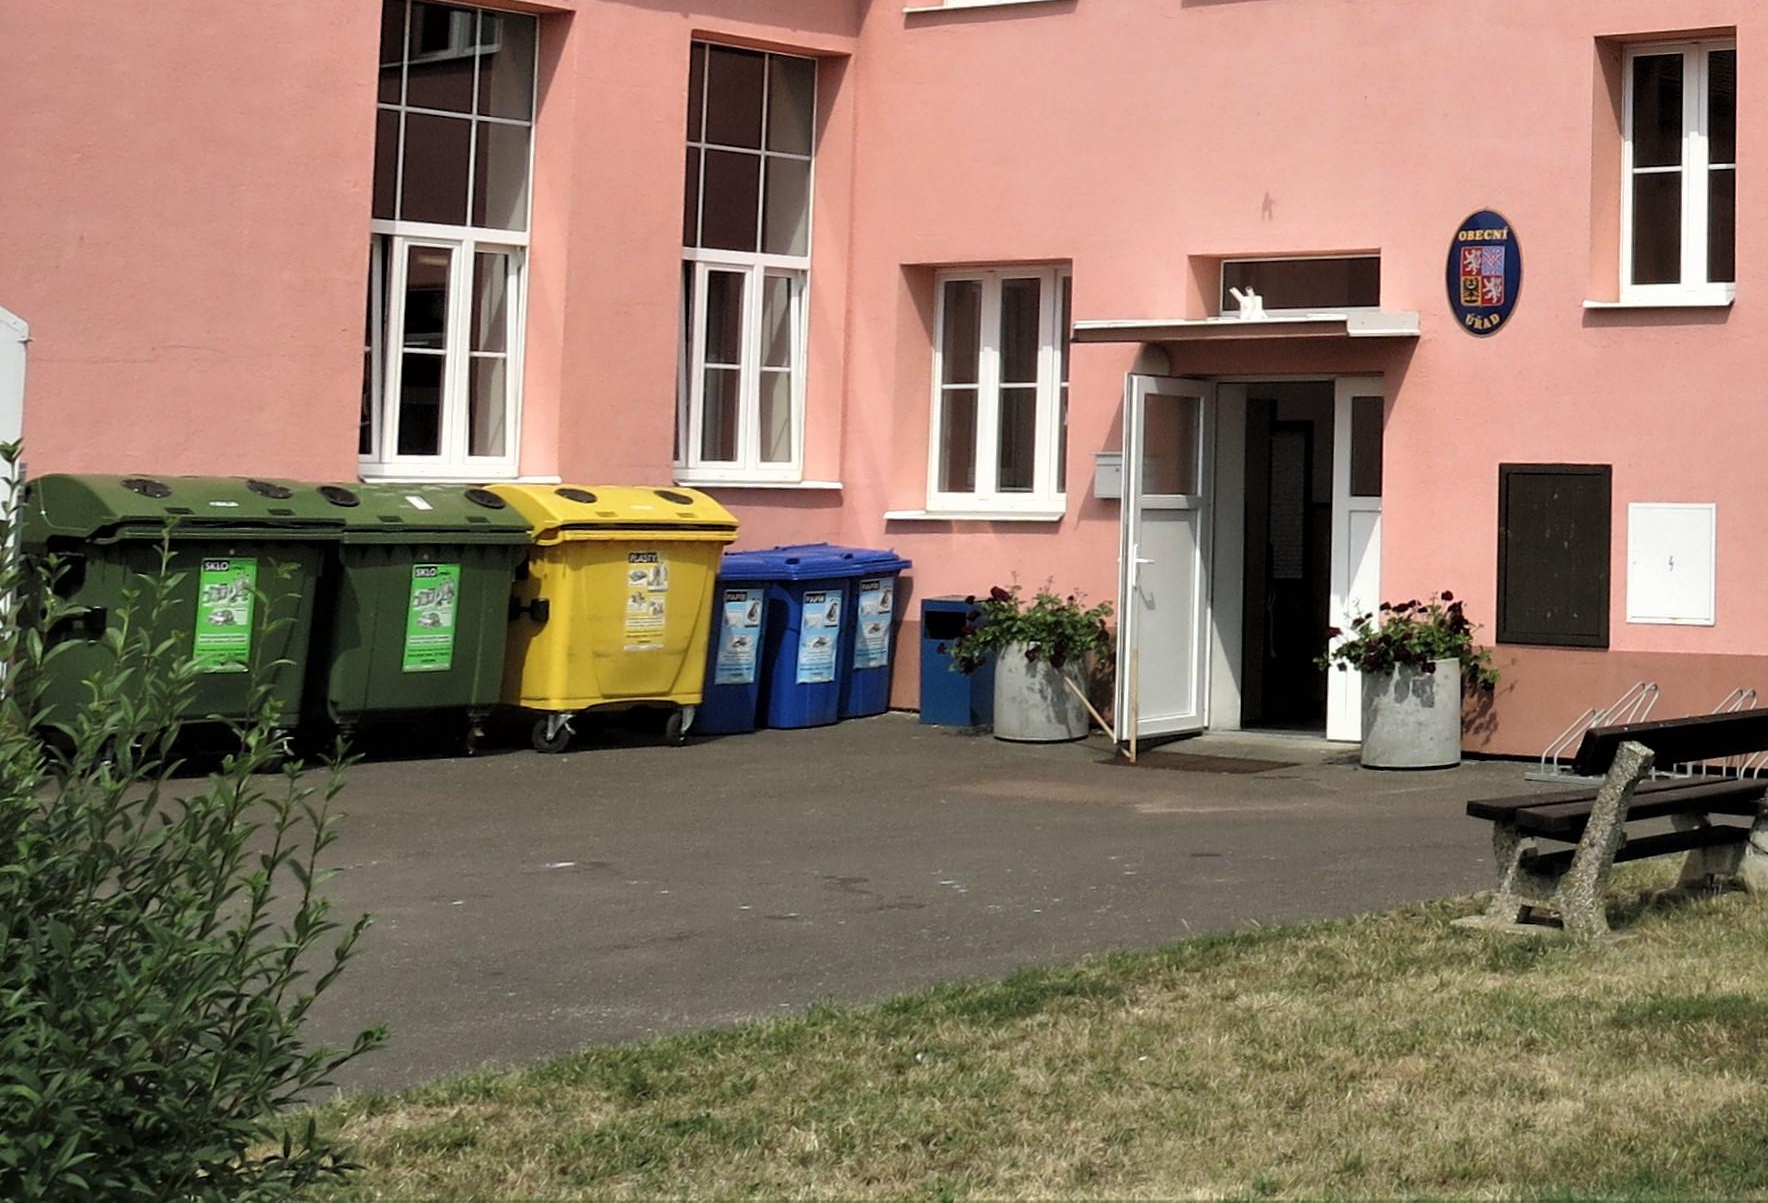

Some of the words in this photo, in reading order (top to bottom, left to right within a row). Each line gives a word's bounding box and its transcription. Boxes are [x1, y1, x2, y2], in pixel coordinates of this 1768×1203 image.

[1458, 226, 1509, 241] OBECNÍ
[1465, 312, 1500, 330] ÚŘAD
[204, 561, 229, 571] SKLO
[415, 567, 437, 577] SKLO
